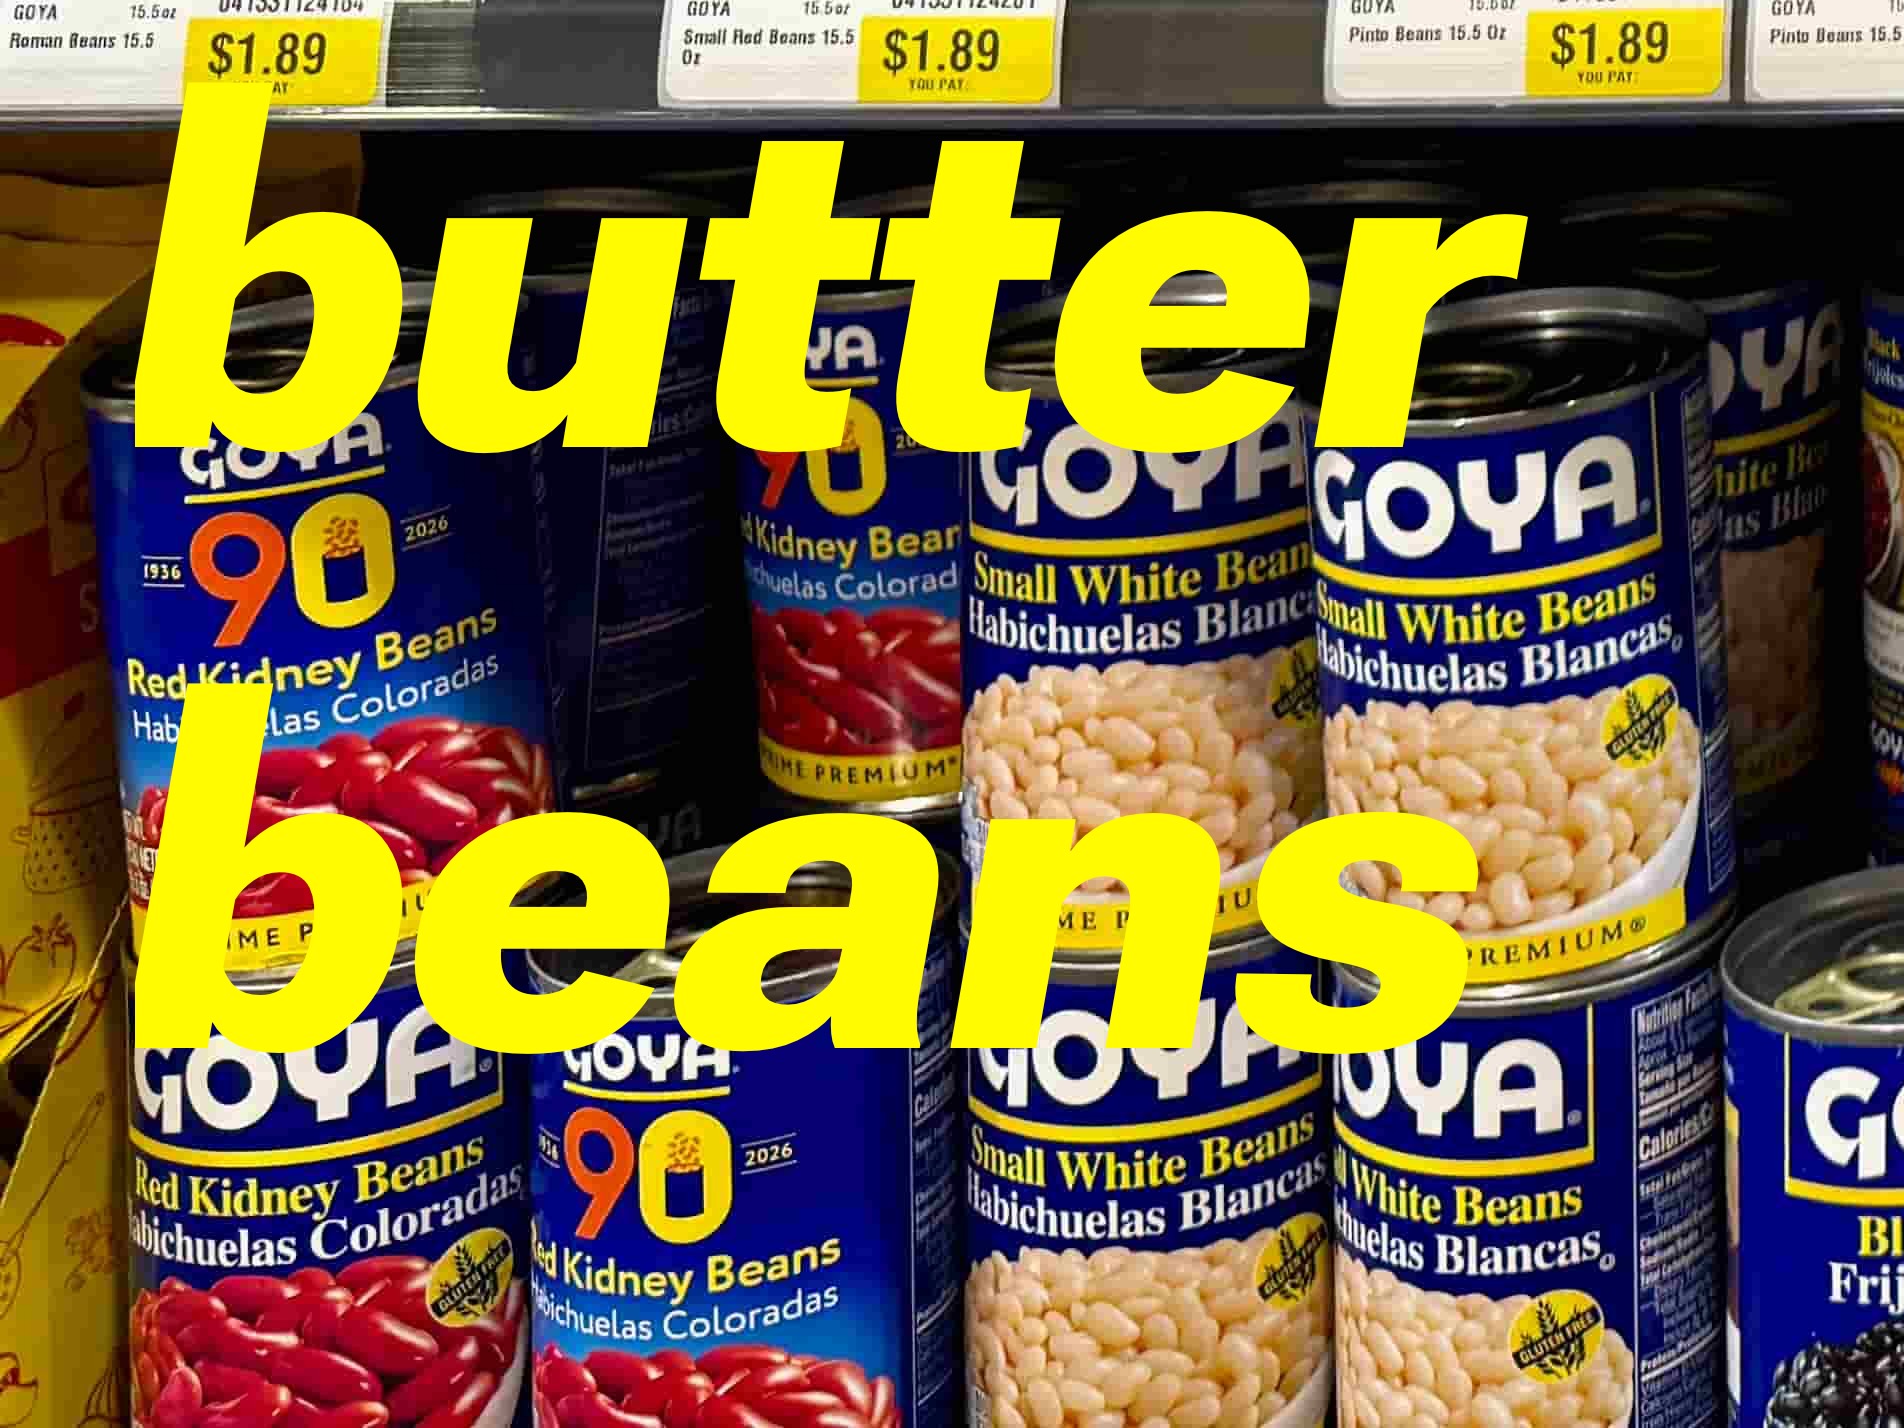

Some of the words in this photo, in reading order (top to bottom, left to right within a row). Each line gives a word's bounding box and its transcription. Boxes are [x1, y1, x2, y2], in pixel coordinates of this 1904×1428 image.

[208, 31, 327, 79] $1.89
[882, 28, 1001, 76] $1.89
[1398, 603, 1528, 645] White
[1537, 573, 1657, 635] Beans
